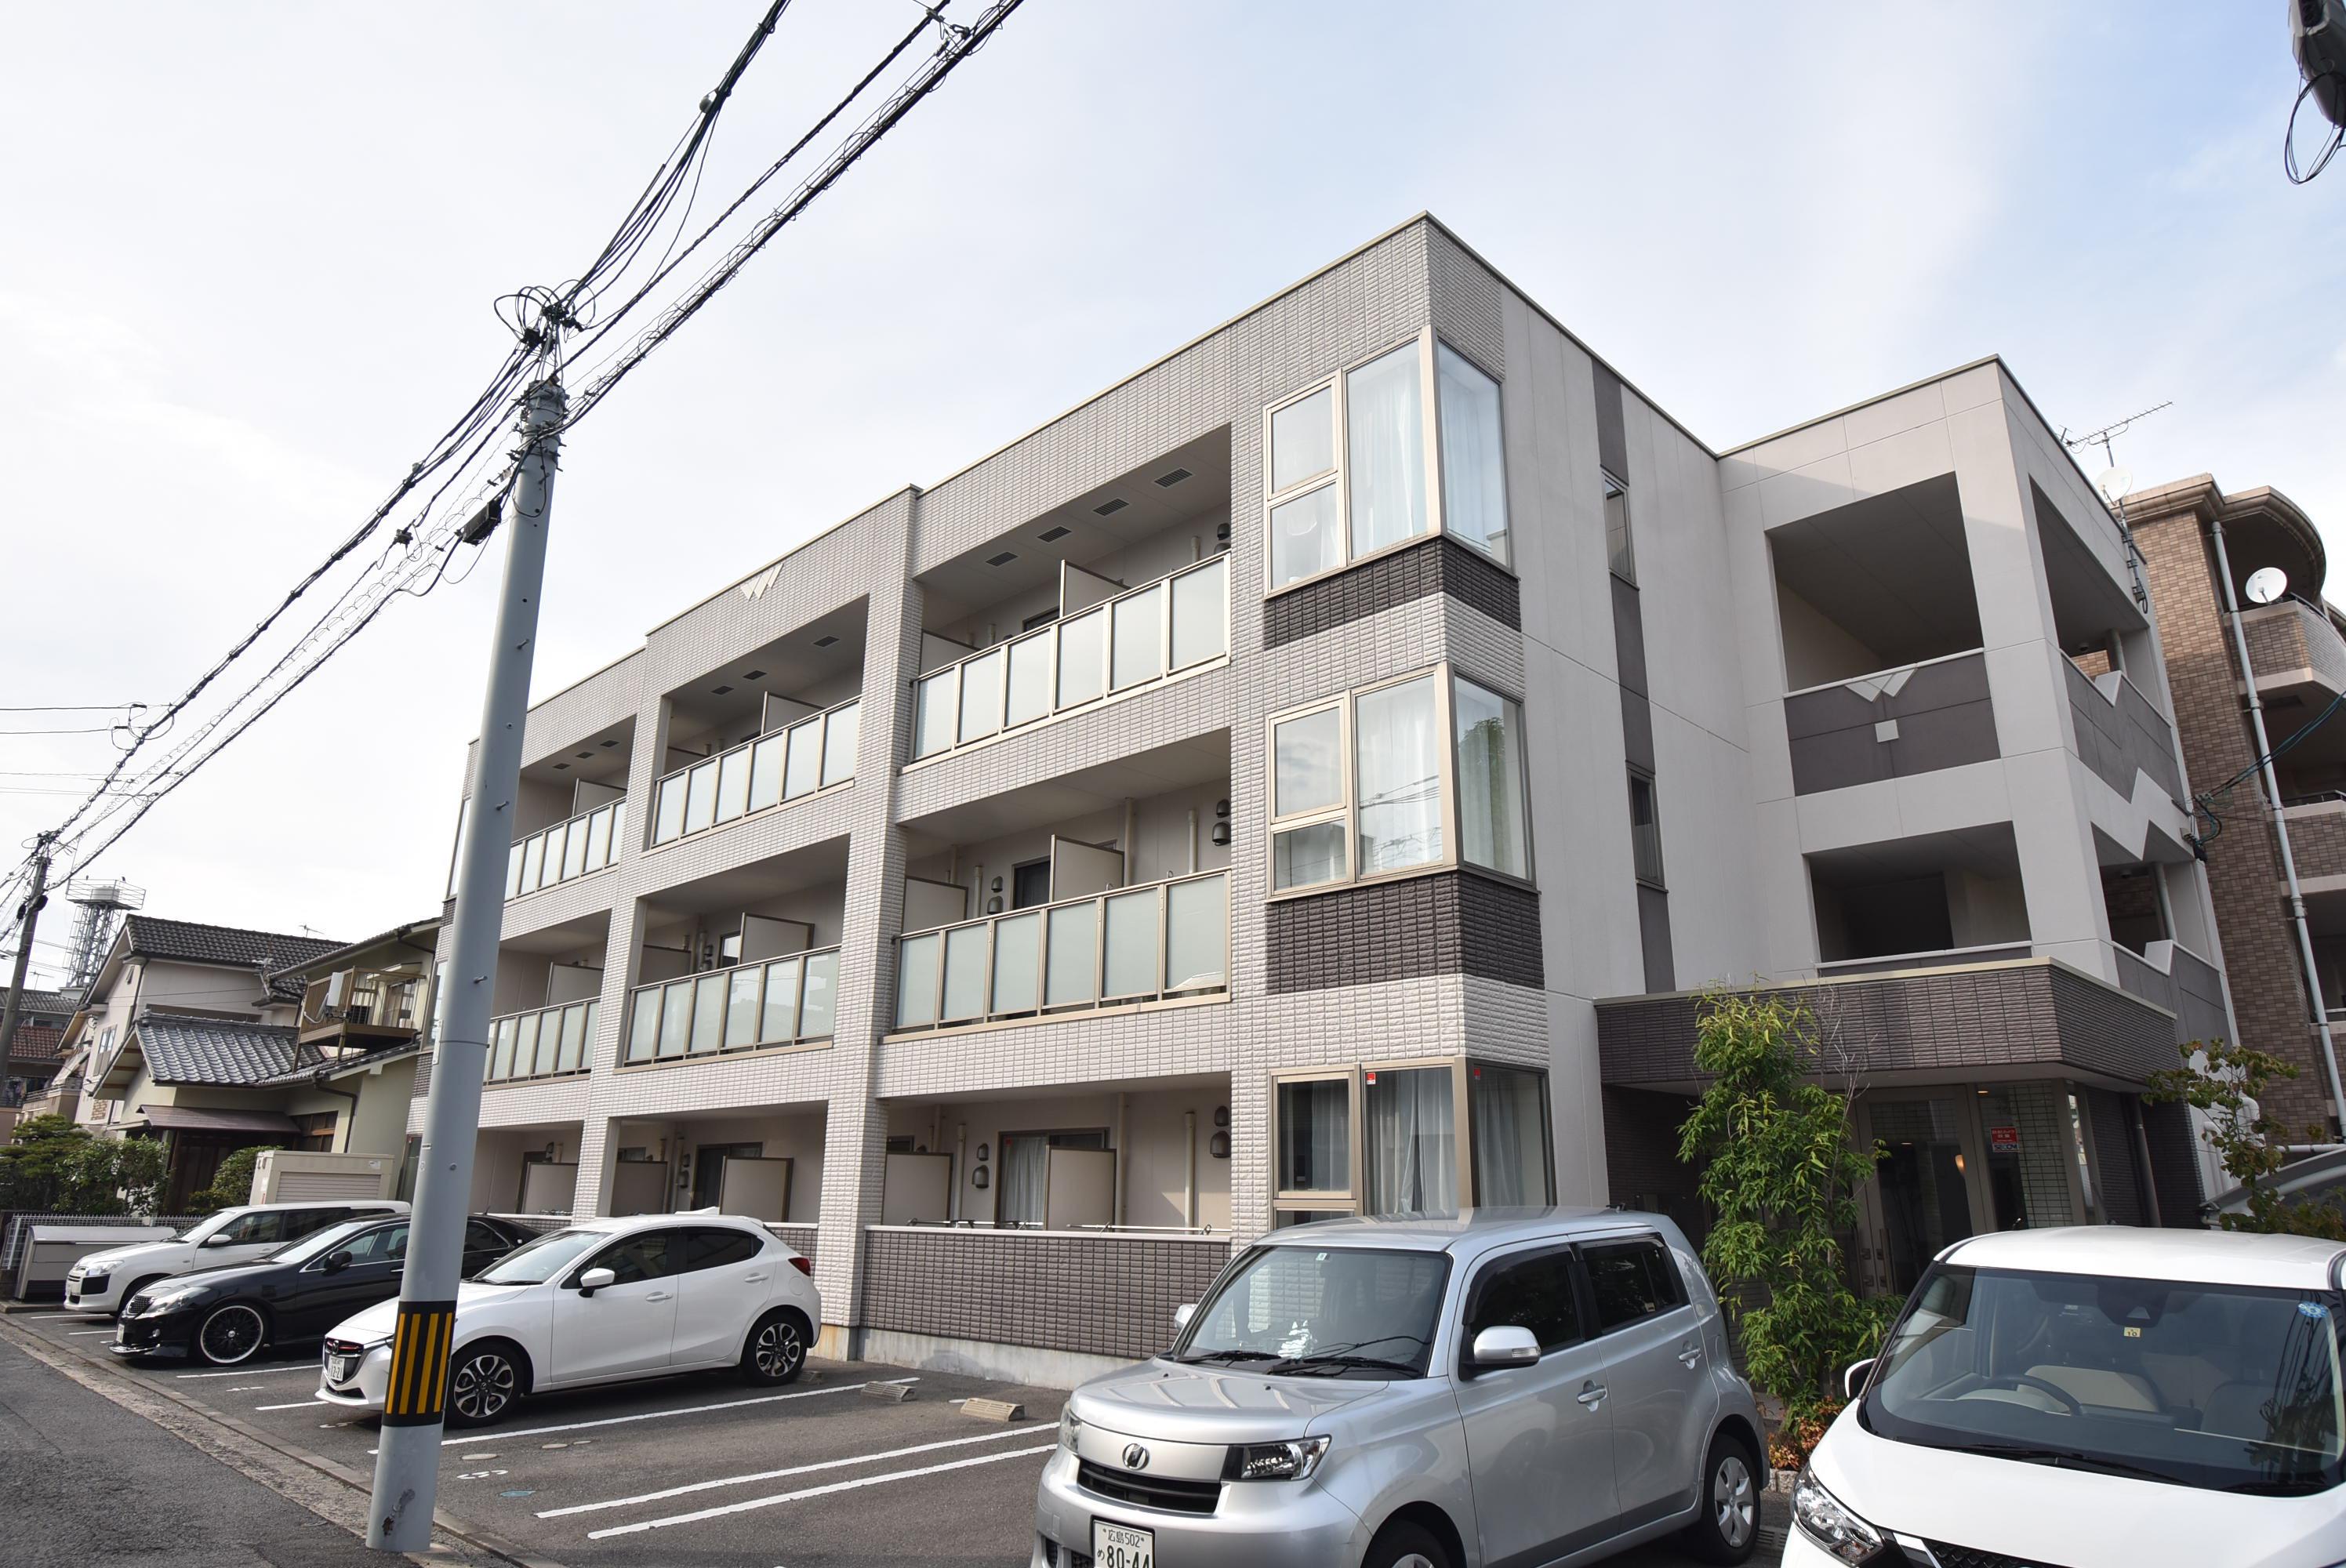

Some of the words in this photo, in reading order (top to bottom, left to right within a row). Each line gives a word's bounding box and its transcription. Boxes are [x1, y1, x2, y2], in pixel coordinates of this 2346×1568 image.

[1108, 1529, 1140, 1548] 広島502
[1097, 1548, 1105, 1561] め
[1107, 1545, 1149, 1568] 80-44
